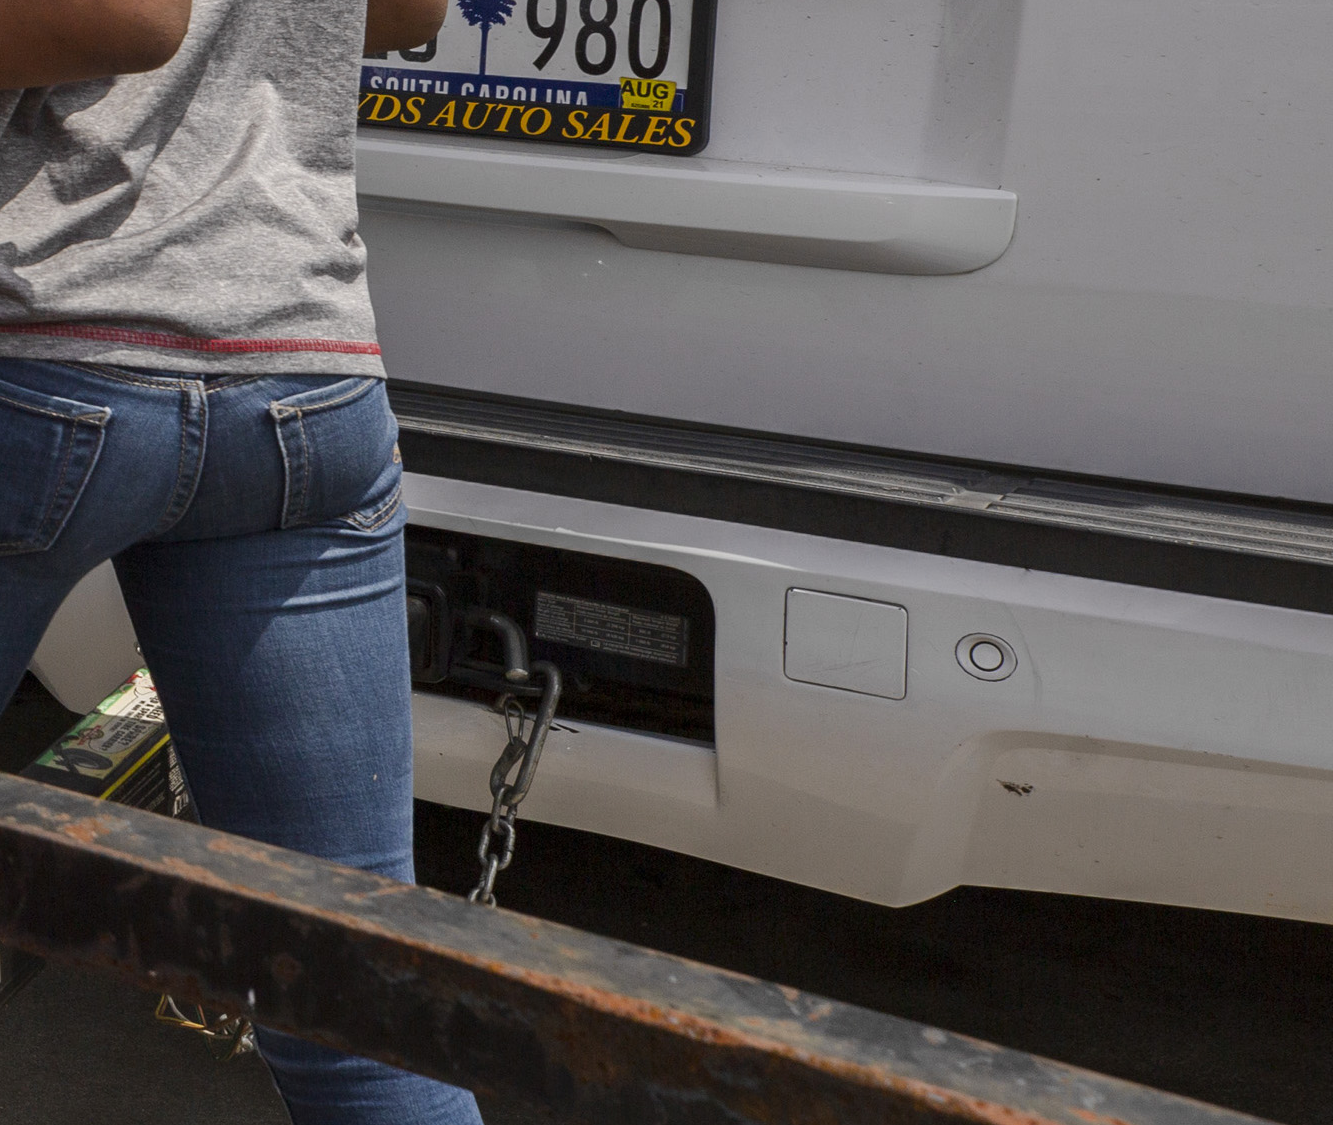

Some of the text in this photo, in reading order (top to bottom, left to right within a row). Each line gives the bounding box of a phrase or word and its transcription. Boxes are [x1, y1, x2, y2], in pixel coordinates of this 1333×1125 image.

[620, 79, 670, 100] AUG
[652, 99, 664, 109] 21
[427, 99, 553, 137] AUTO
[561, 109, 697, 149] SALES
